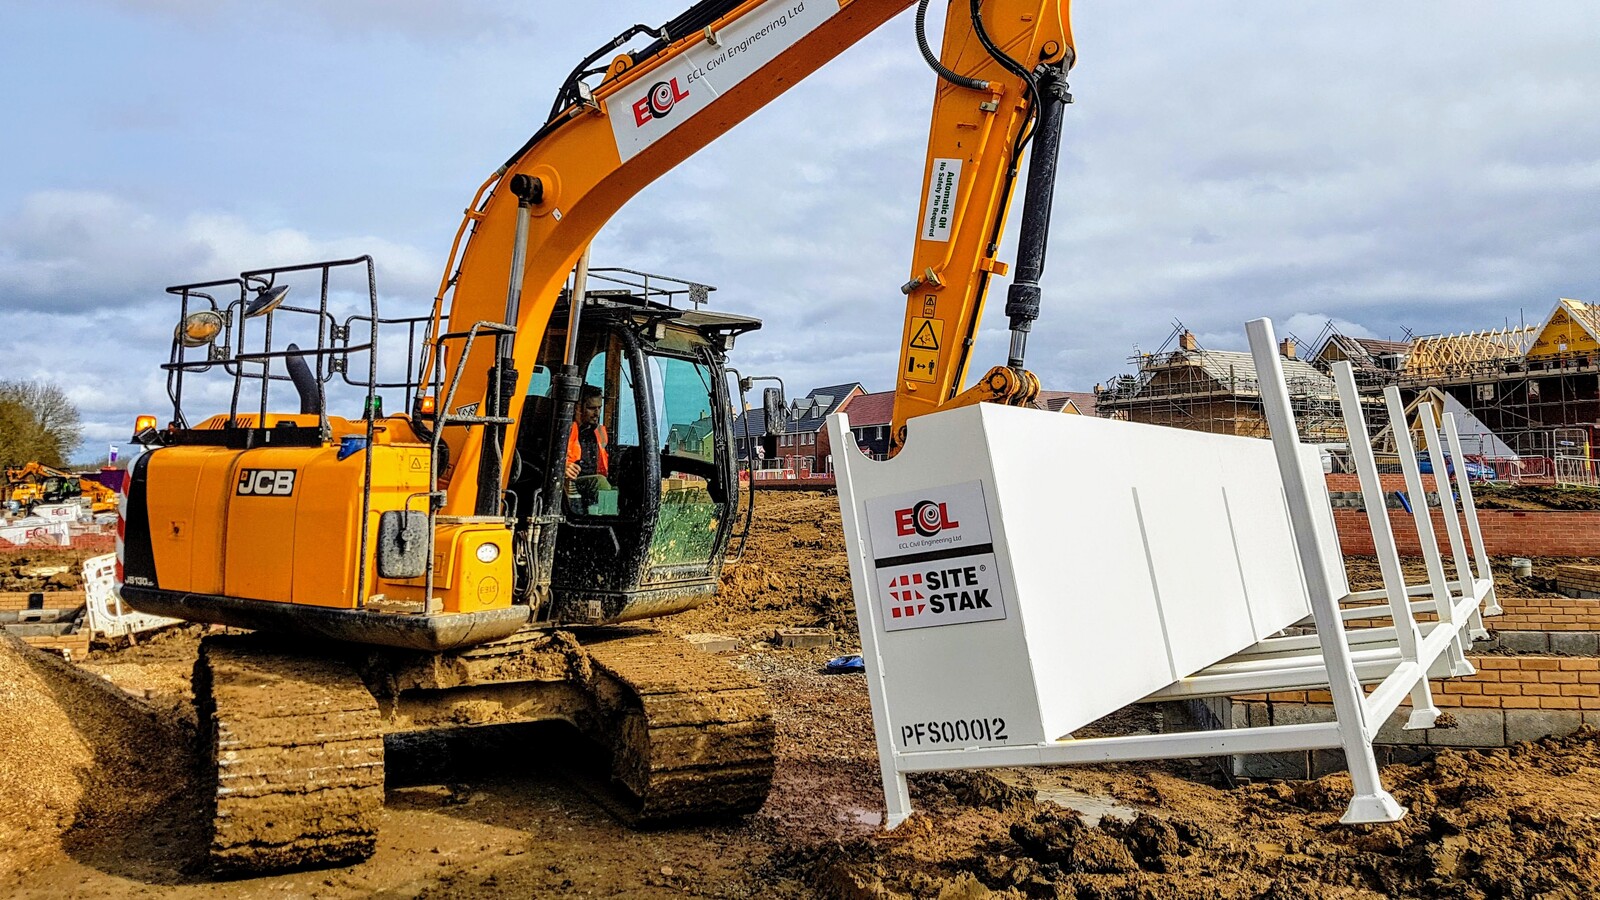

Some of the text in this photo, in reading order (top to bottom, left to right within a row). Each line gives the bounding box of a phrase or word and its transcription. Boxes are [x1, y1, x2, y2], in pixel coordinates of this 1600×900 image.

[687, 2, 805, 84] ECL Civil Engineering Ltd
[632, 77, 690, 128] ECL
[928, 161, 947, 237] No Safety Pin Required
[938, 171, 955, 229] Automatic QH
[237, 470, 296, 496] JCB
[895, 500, 960, 537] ECL
[921, 537, 953, 547] Engineering
[929, 588, 993, 614] STAK
